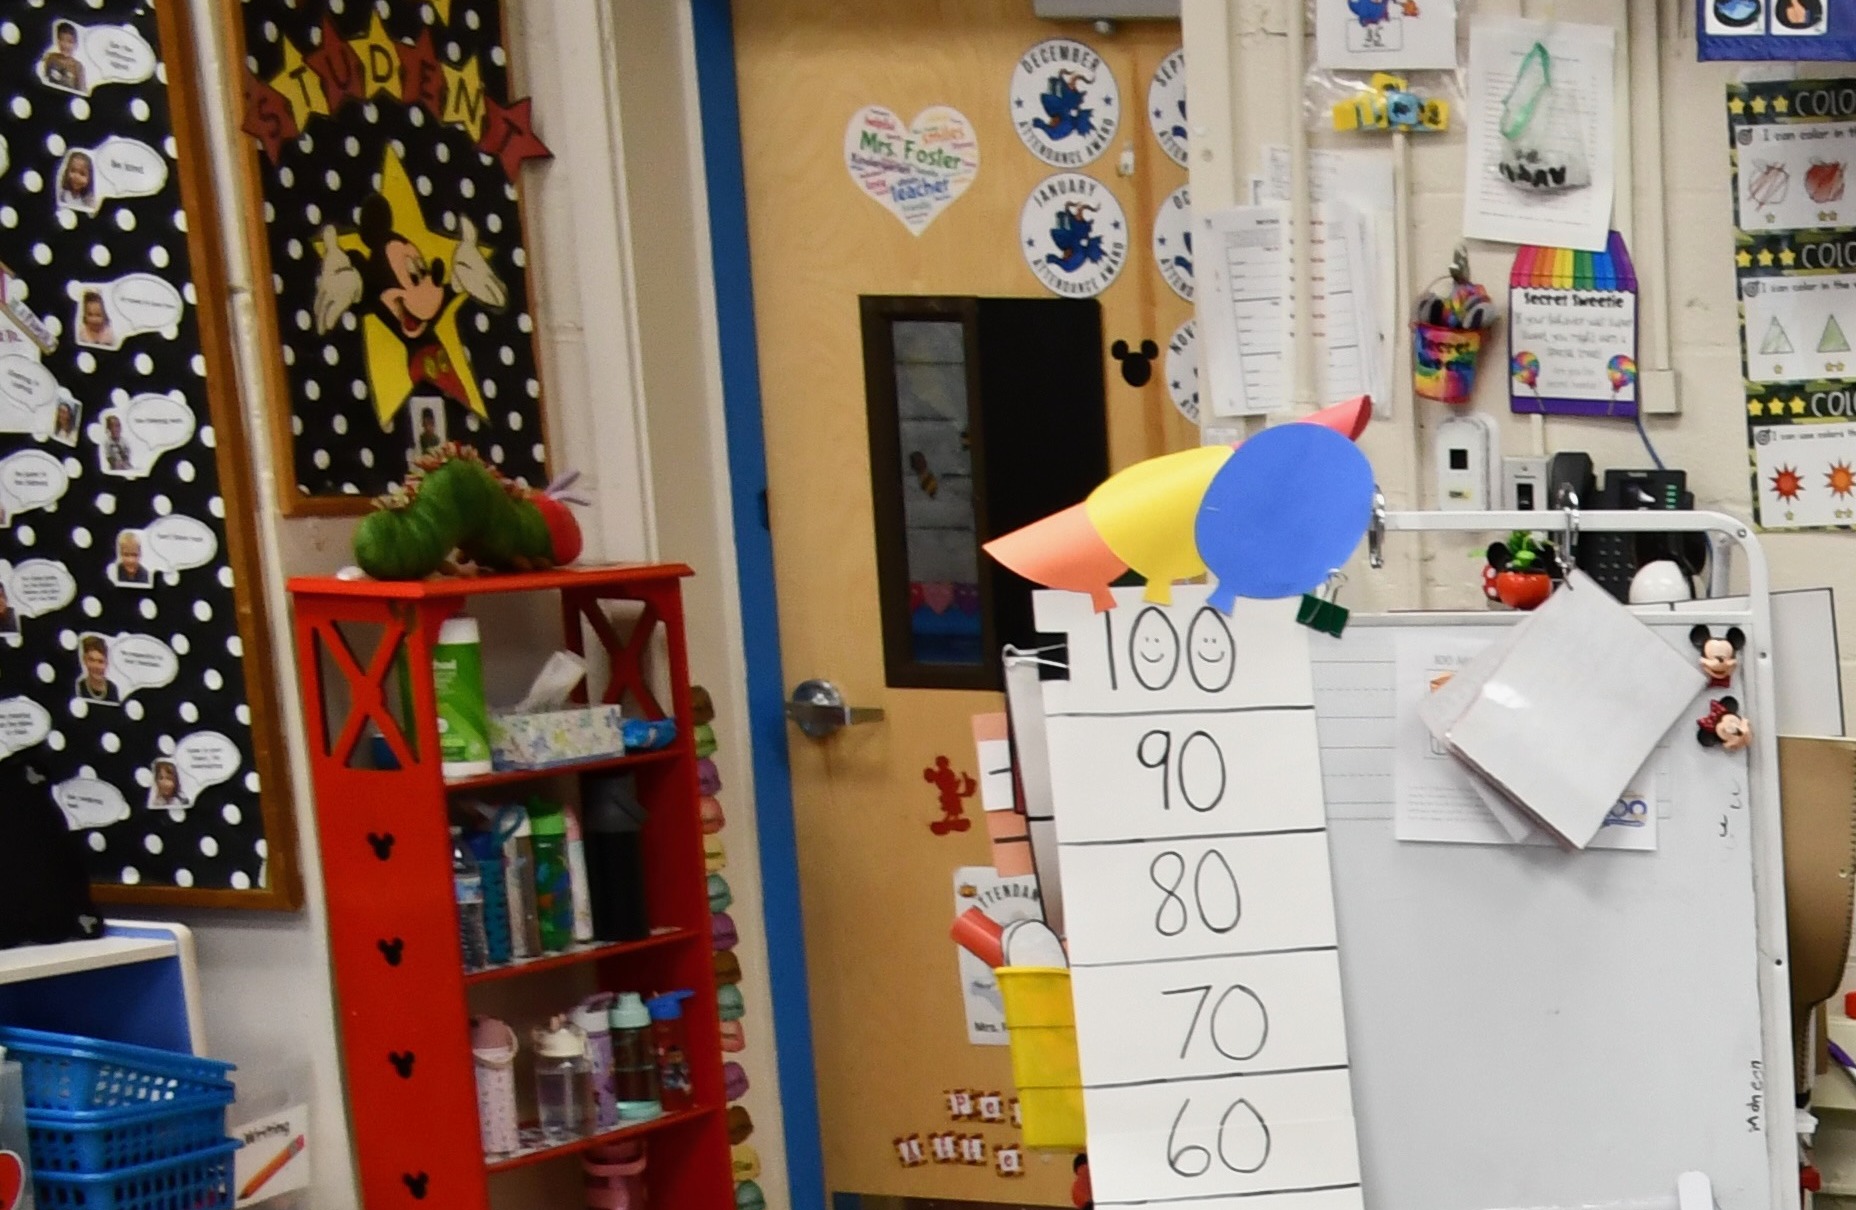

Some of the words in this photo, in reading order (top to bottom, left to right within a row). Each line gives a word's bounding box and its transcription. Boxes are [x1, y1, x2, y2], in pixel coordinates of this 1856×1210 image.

[1020, 45, 1101, 75] DECEMBER
[258, 44, 524, 148] STUDENT
[905, 139, 960, 170] Foster
[1018, 120, 1083, 165] ATTENDANCE
[1086, 117, 1115, 157] AWARD
[1775, 132, 1795, 141] can
[1799, 130, 1829, 140] color
[1034, 178, 1097, 208] JANUARY
[1032, 258, 1098, 295] ATTENDANCE
[1101, 241, 1125, 282] AWARD
[1524, 293, 1568, 307] Secret
[1572, 294, 1625, 309] Sweetie
[1104, 607, 1235, 691] 100
[1137, 730, 1225, 813] 90
[1150, 850, 1241, 936] 80
[1161, 984, 1268, 1060] 70
[1167, 1098, 1271, 1177] 60
